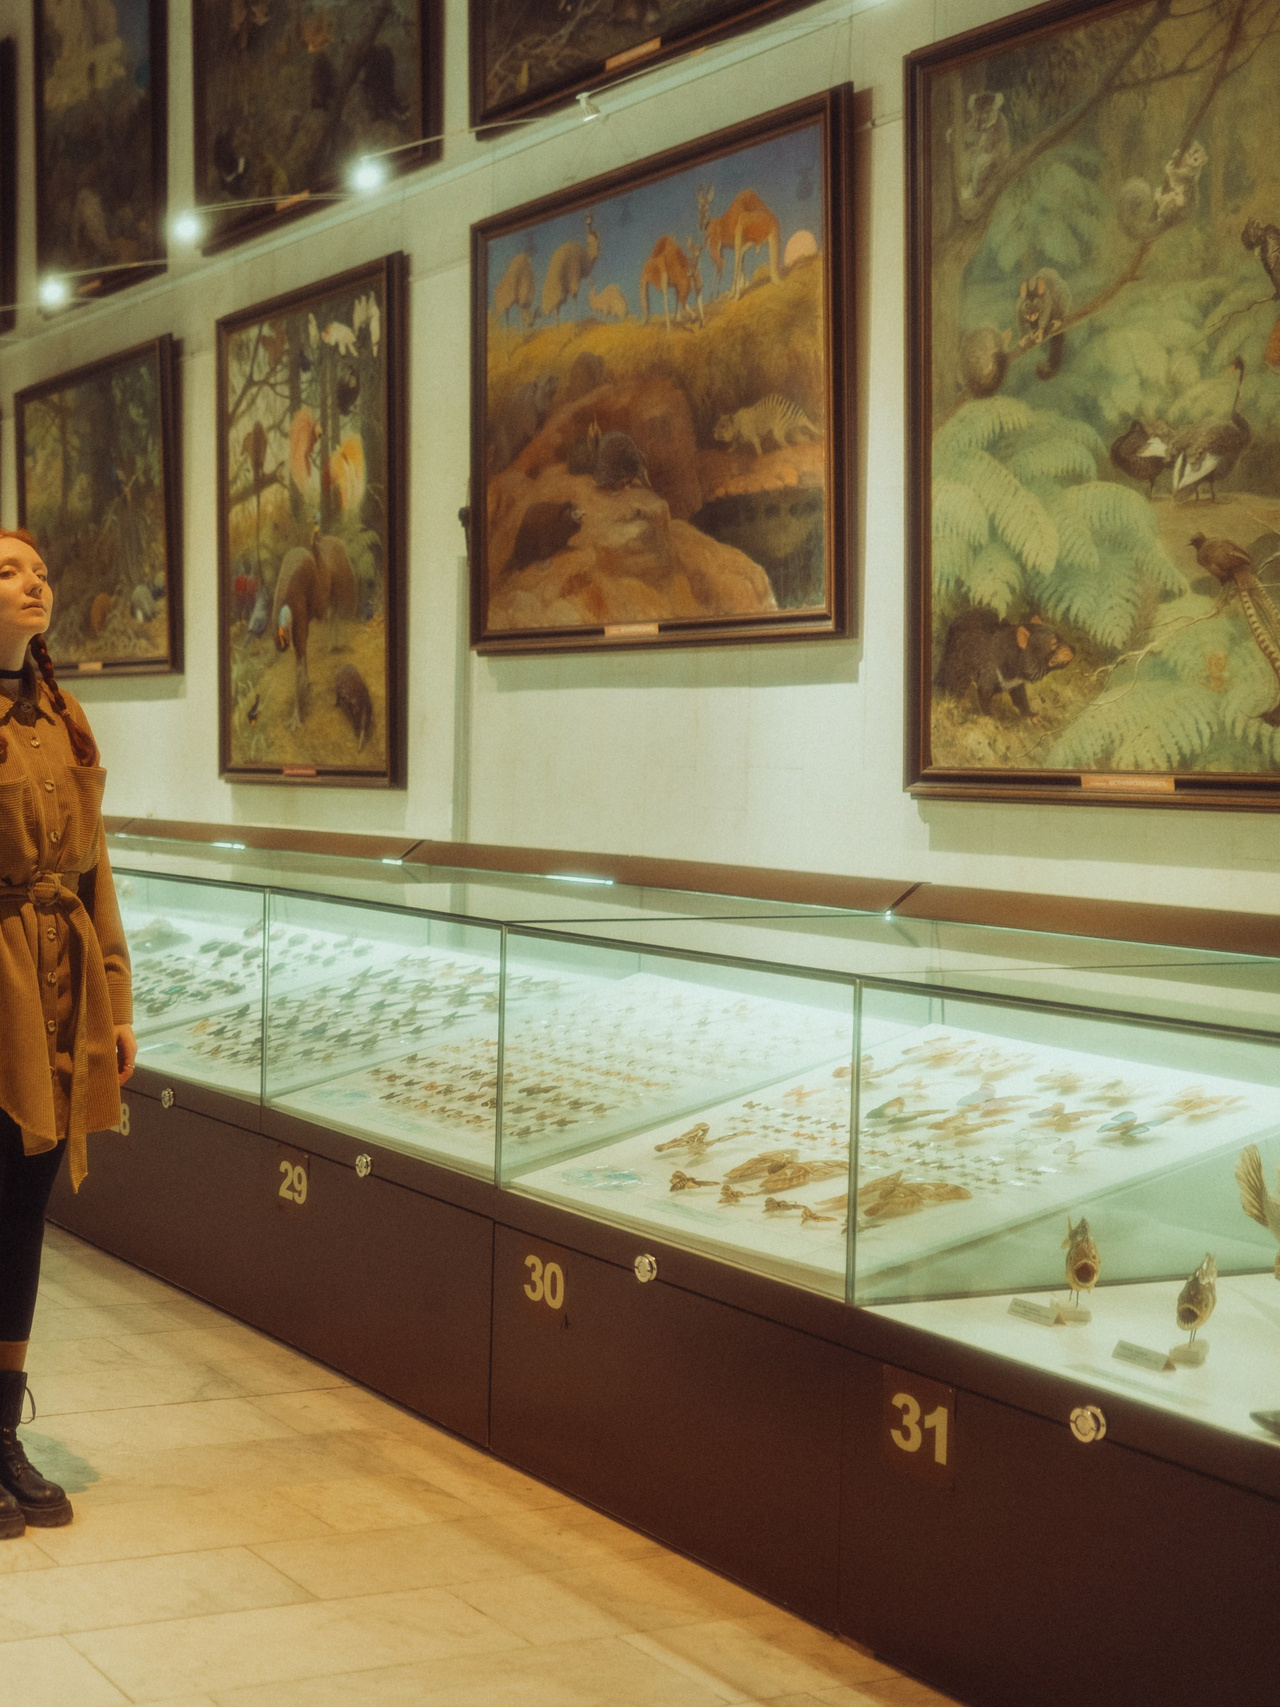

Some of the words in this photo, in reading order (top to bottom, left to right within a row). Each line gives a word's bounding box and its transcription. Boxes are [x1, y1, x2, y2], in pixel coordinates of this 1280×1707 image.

[109, 1102, 130, 1136] 8
[278, 1160, 308, 1205] 29
[523, 1254, 565, 1310] 30
[890, 1392, 949, 1466] 31
